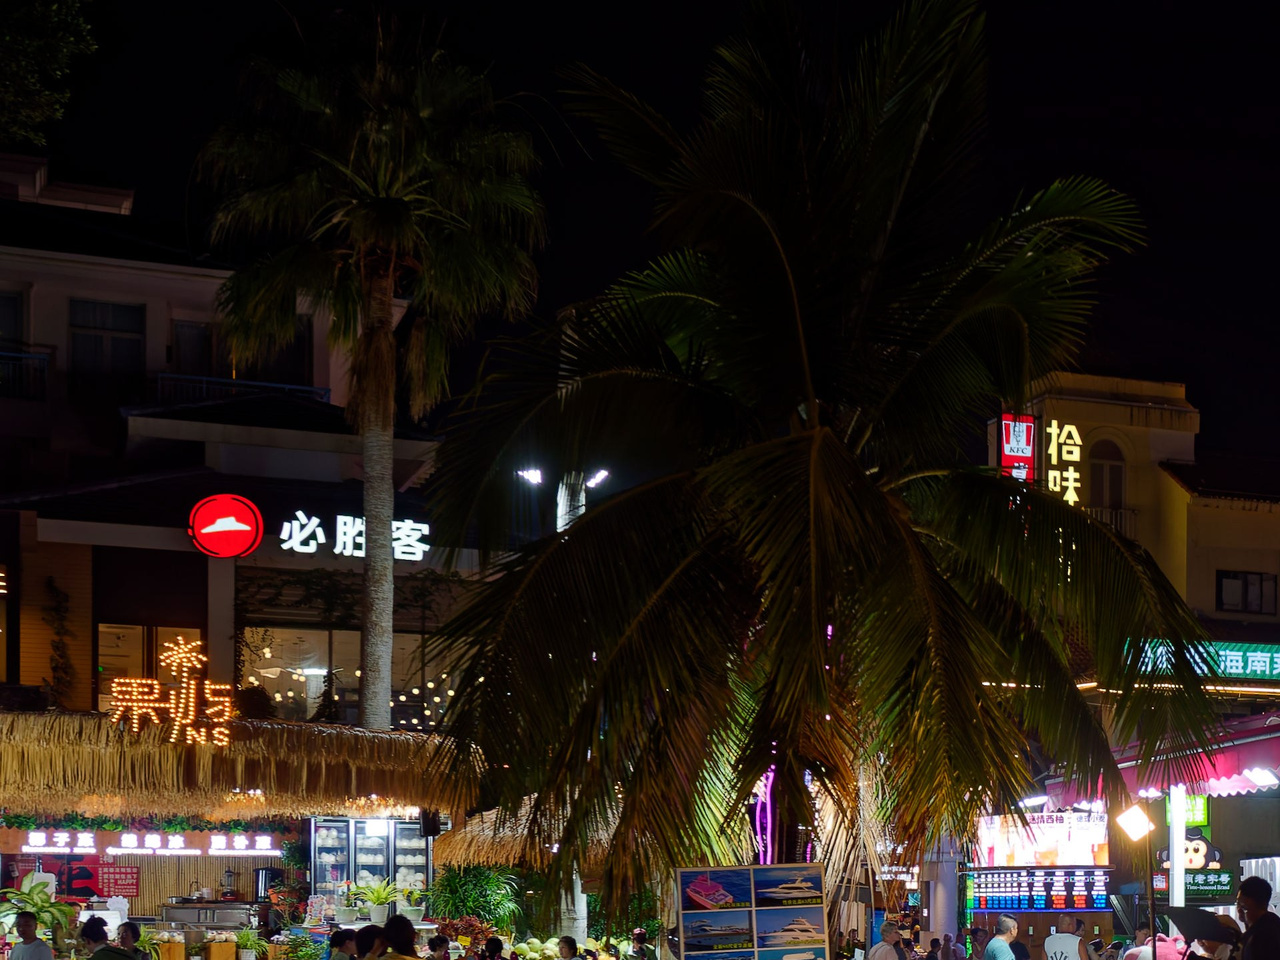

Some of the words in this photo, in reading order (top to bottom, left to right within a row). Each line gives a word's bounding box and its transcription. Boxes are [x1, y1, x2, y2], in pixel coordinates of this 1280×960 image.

[1009, 446, 1028, 455] KFC
[279, 510, 431, 561] 必胜客
